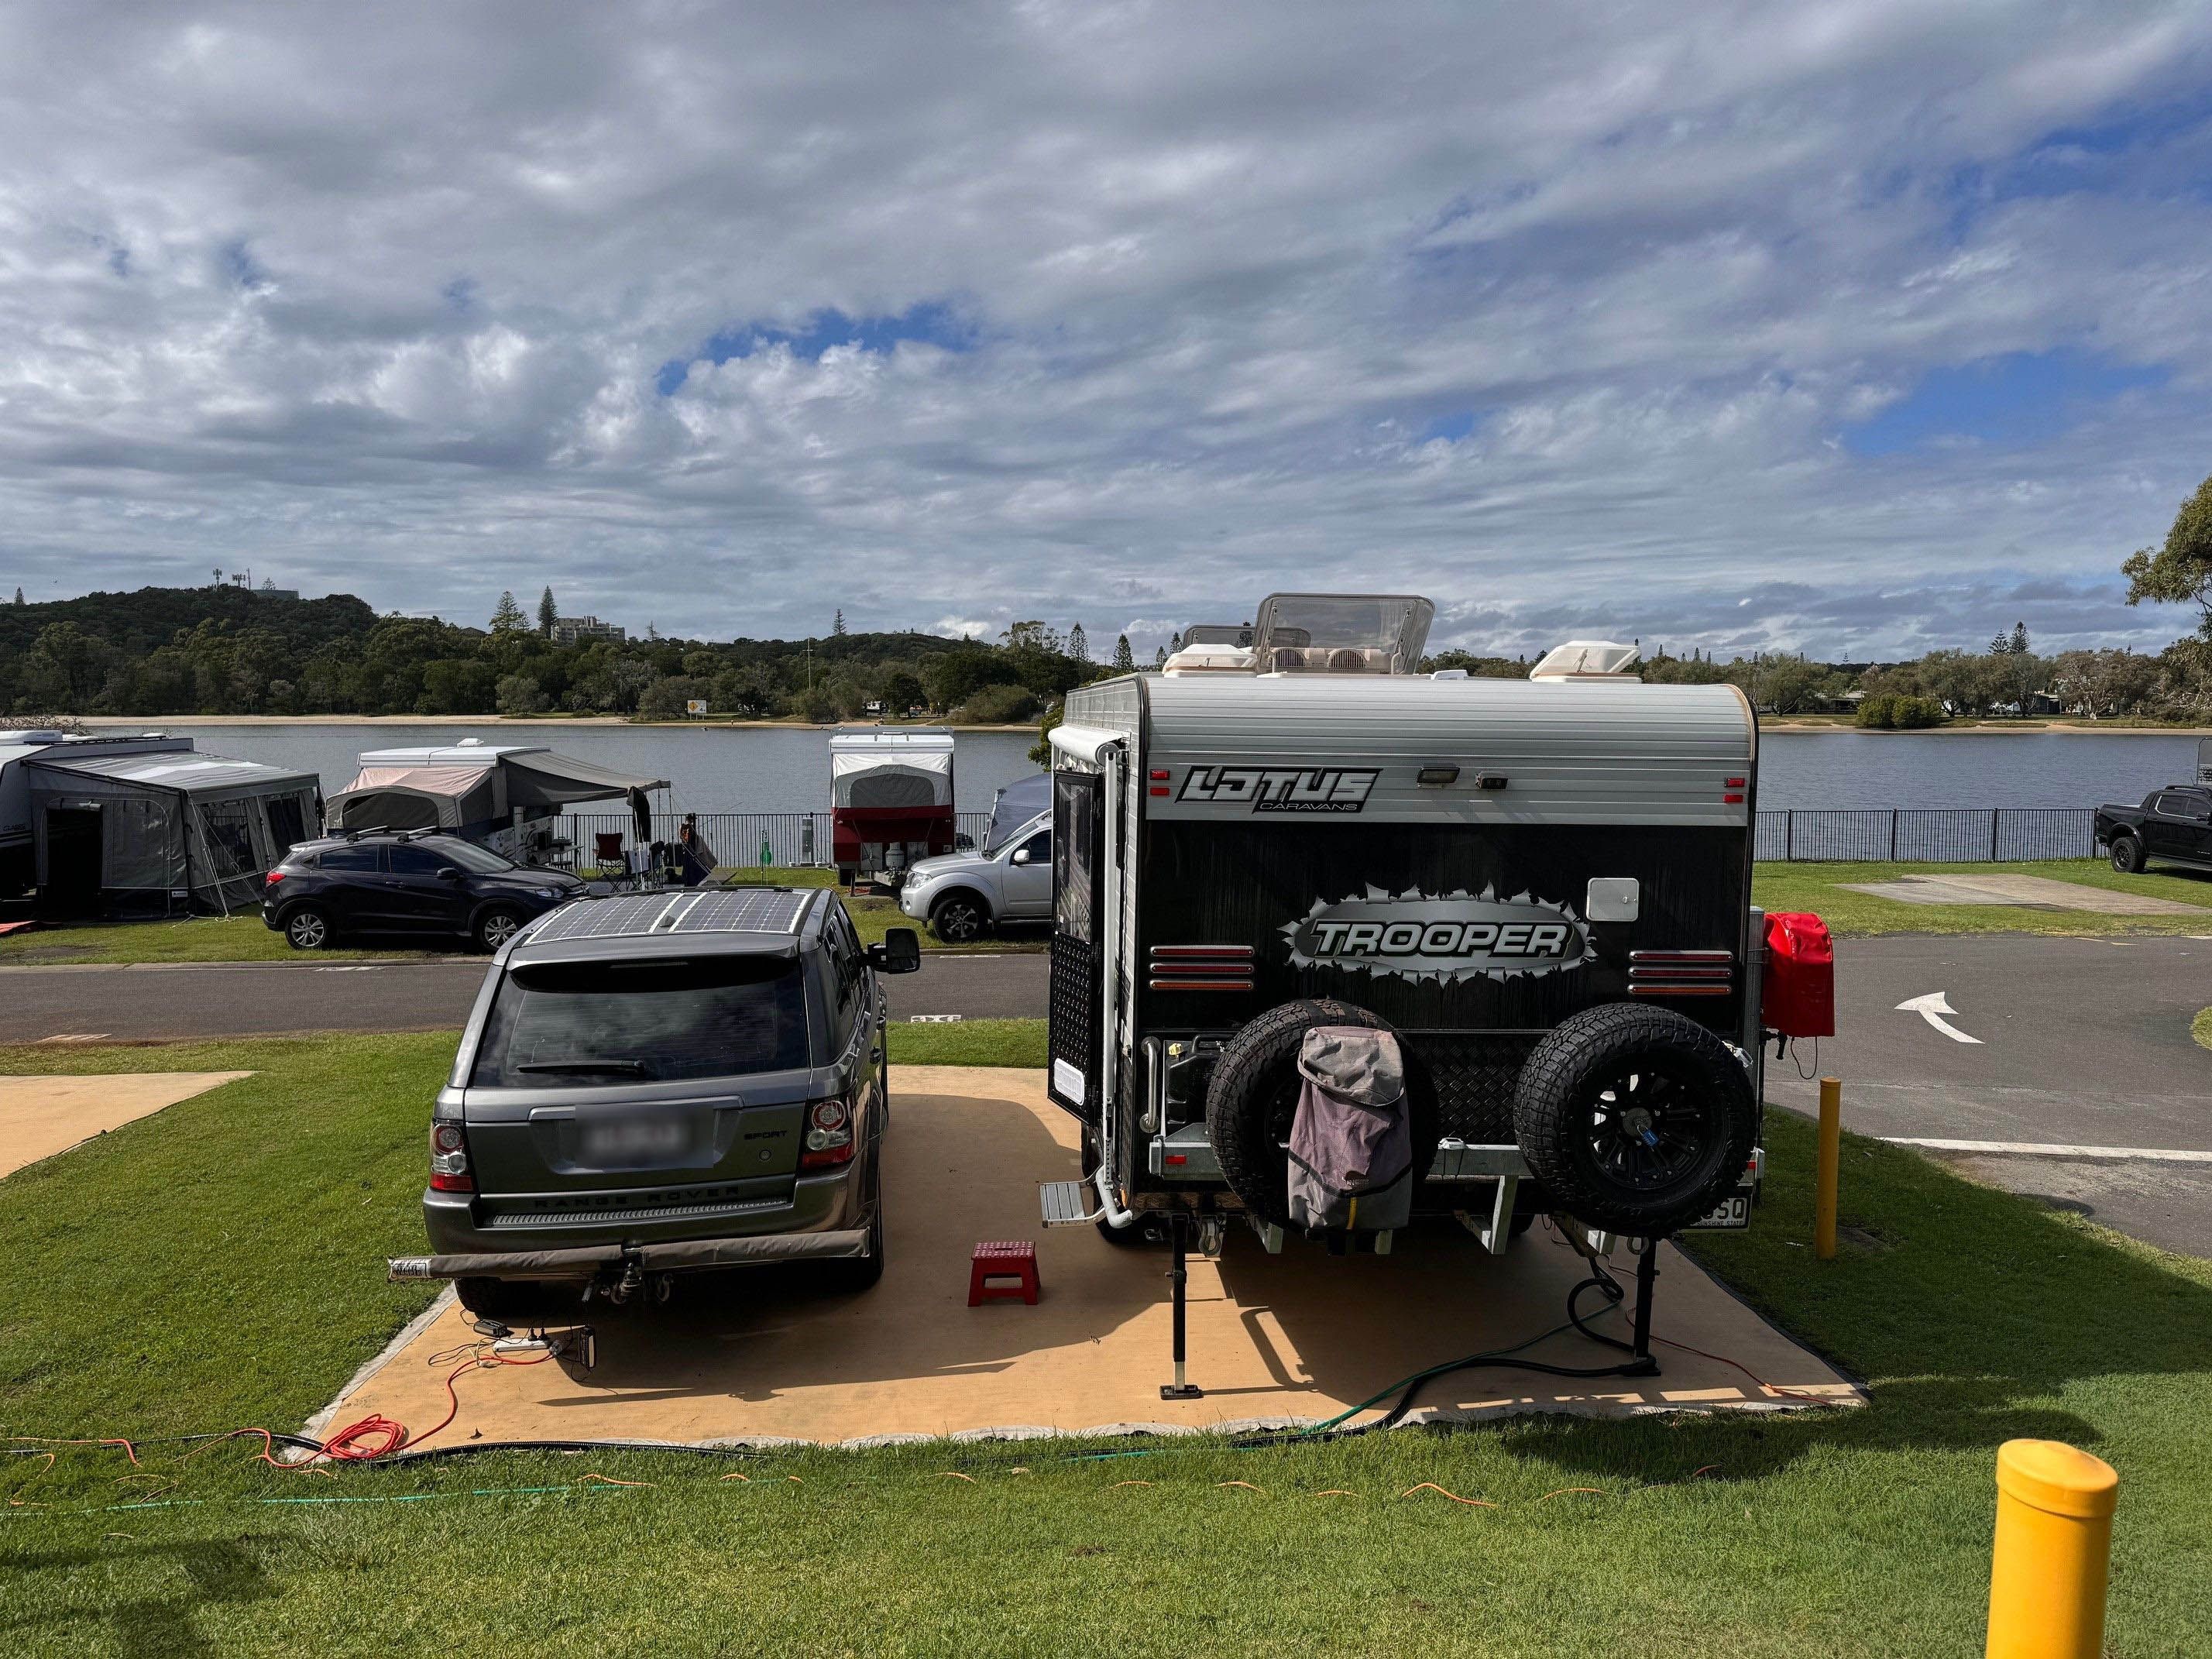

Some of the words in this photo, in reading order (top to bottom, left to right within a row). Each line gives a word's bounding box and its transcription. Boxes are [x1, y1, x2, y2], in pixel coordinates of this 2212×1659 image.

[1179, 766, 1381, 802] LOTUS
[1259, 802, 1358, 811] CARAVANS
[1316, 923, 1568, 953] TROOPER
[744, 1130, 788, 1140] SPORT
[534, 1197, 627, 1208] RANGE
[647, 1187, 740, 1204] ROVER
